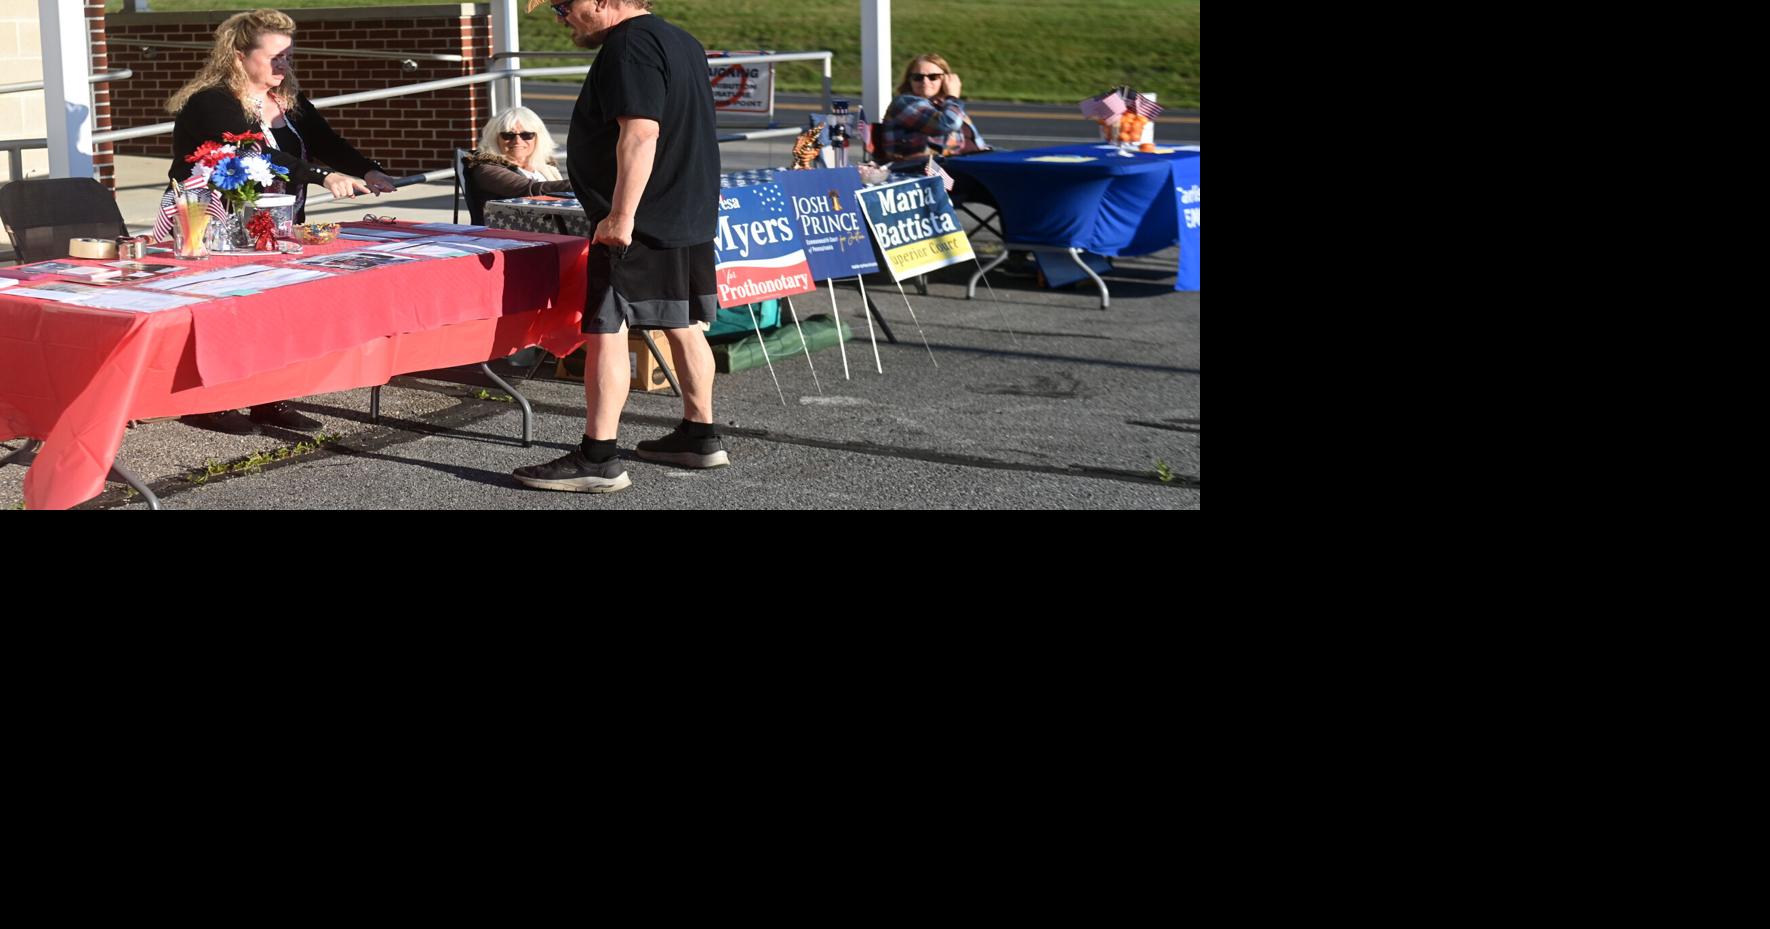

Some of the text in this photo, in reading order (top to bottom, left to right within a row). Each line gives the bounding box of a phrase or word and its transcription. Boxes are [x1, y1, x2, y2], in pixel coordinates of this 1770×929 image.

[792, 195, 830, 221] JOSH
[877, 183, 936, 216] Maria
[714, 215, 794, 258] Myers
[800, 212, 860, 236] PRINCE
[875, 213, 957, 249] Battista
[889, 238, 959, 267] uperior Court
[718, 273, 809, 302] Prothonotary
